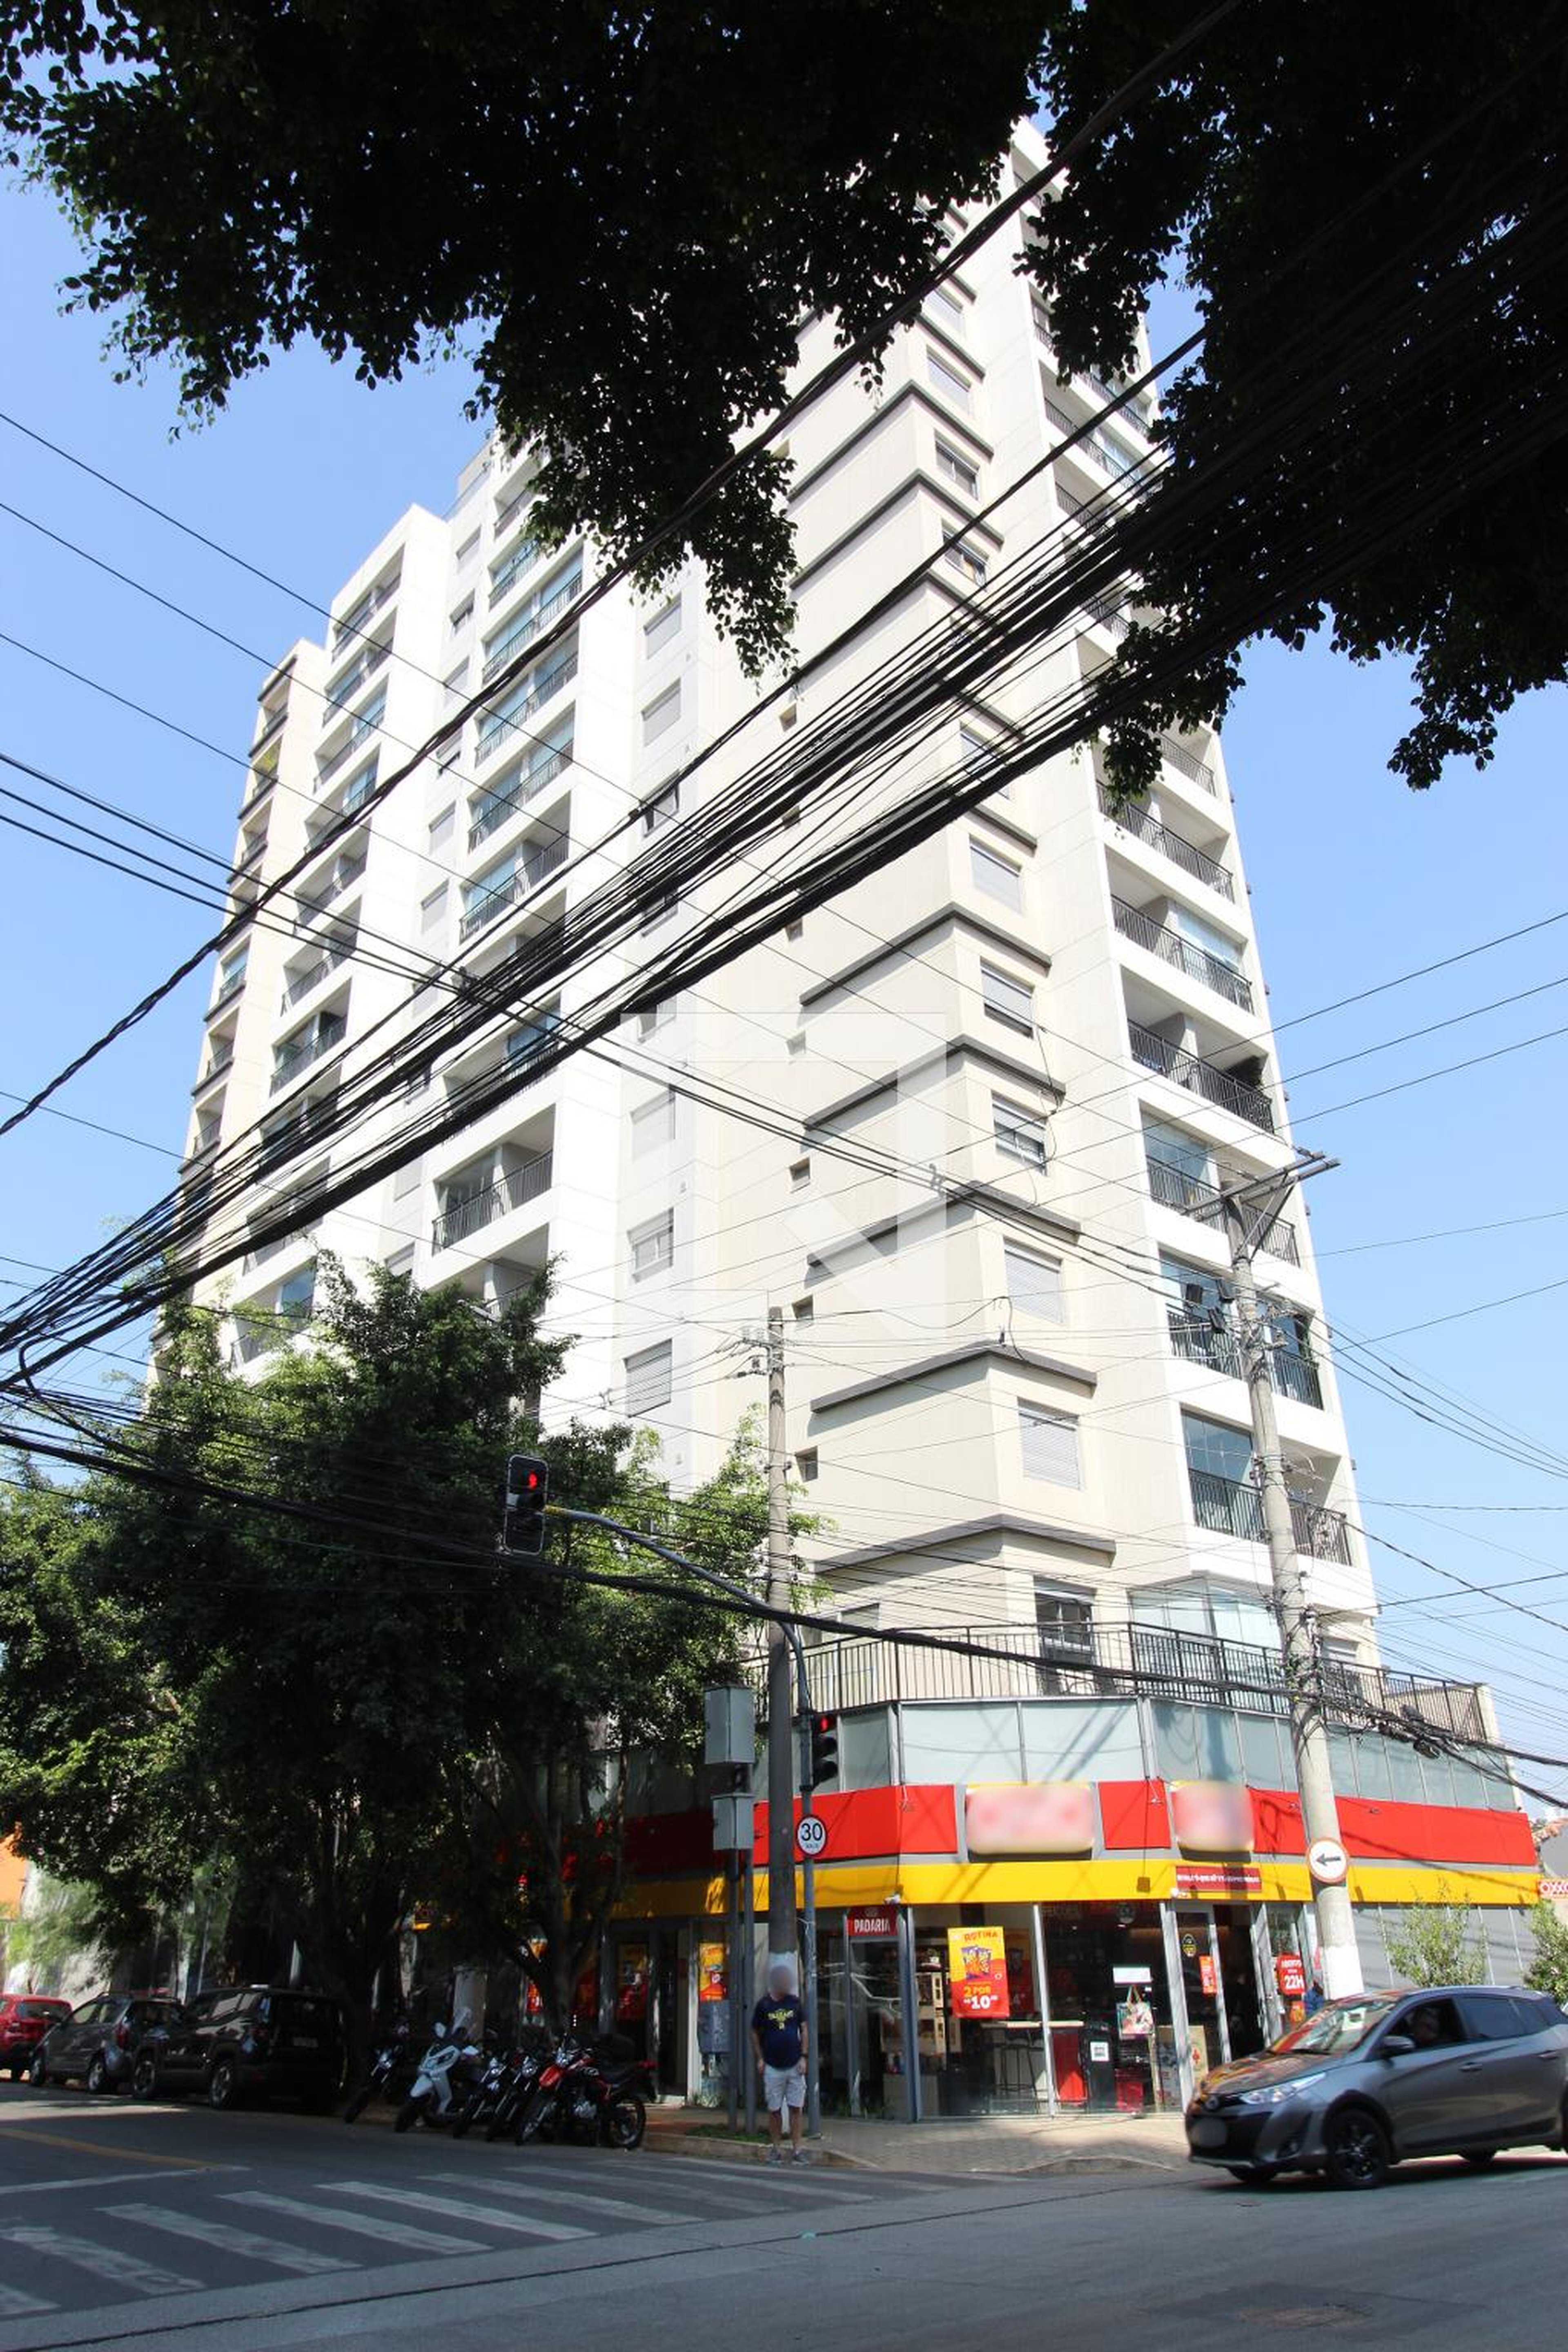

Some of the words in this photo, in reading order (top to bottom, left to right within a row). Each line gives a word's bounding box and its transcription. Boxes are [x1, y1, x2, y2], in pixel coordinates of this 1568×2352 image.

[802, 1823, 823, 1841] 30
[854, 1918, 890, 1933] PADARIA
[1284, 1974, 1305, 1989] 22H
[964, 1985, 971, 1997] 2
[971, 1995, 991, 2009] 10
